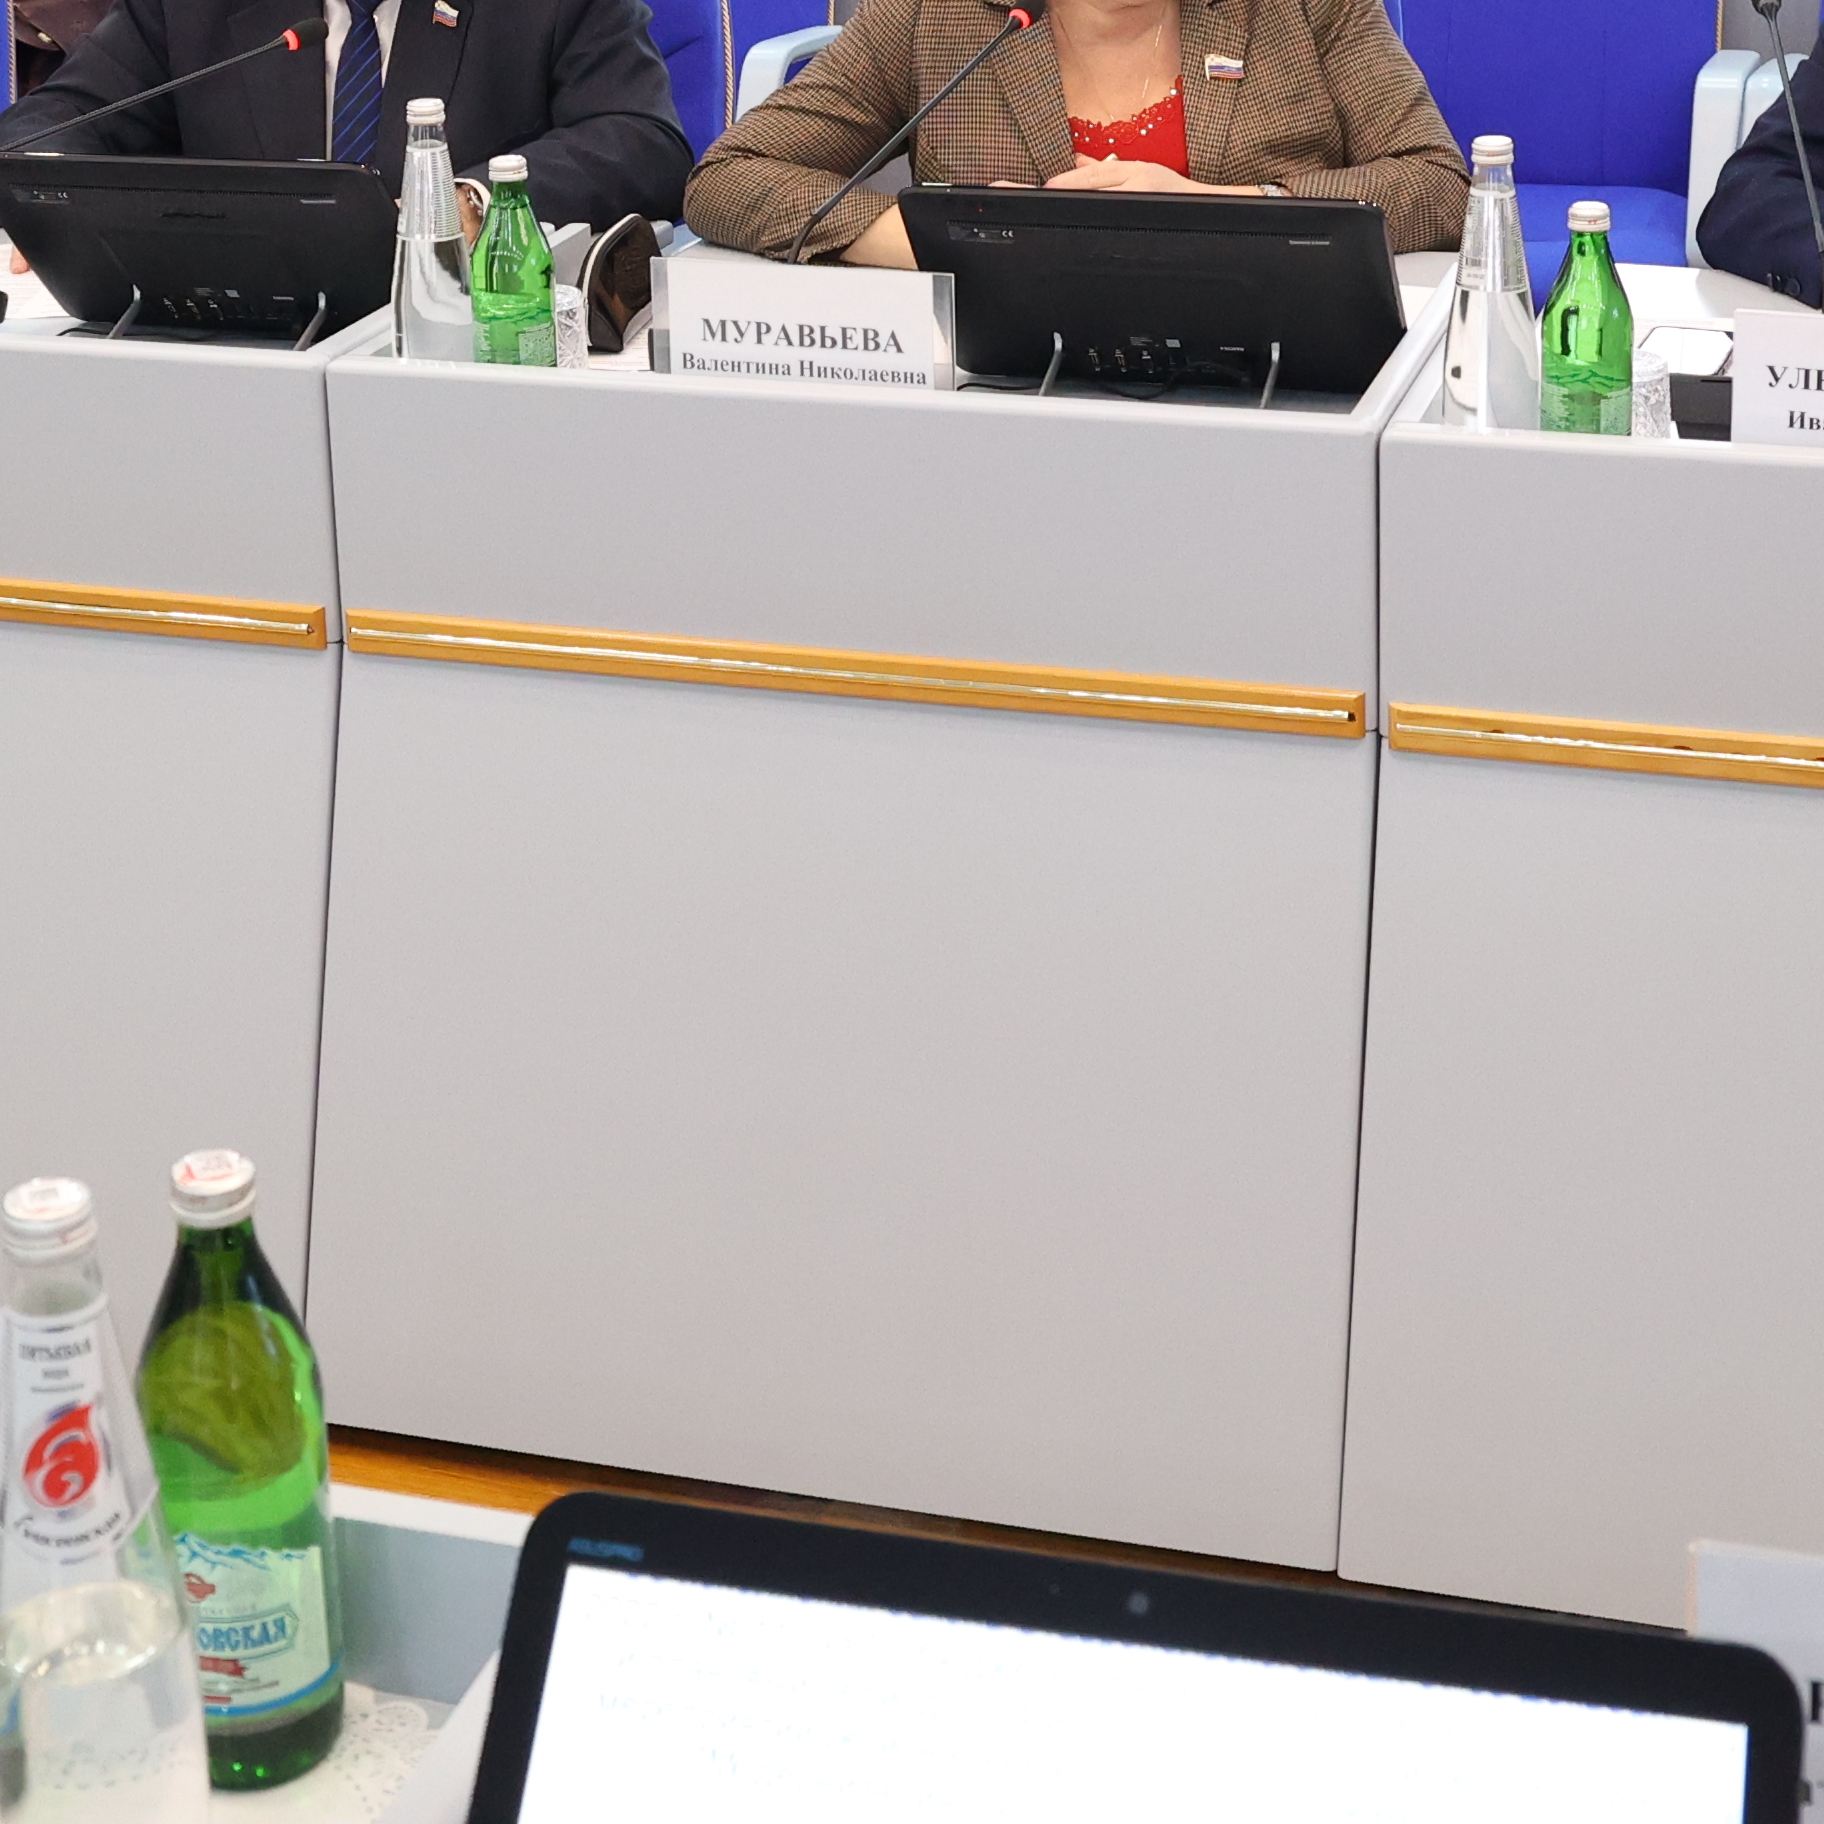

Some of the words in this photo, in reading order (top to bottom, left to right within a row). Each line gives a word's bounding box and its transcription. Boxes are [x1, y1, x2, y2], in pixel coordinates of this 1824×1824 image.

[700, 317, 904, 354] МУРАВЬЕВА
[681, 352, 791, 376] Валентина
[799, 360, 927, 385] Николаевна
[198, 1617, 286, 1651] ОВСКАЯ
